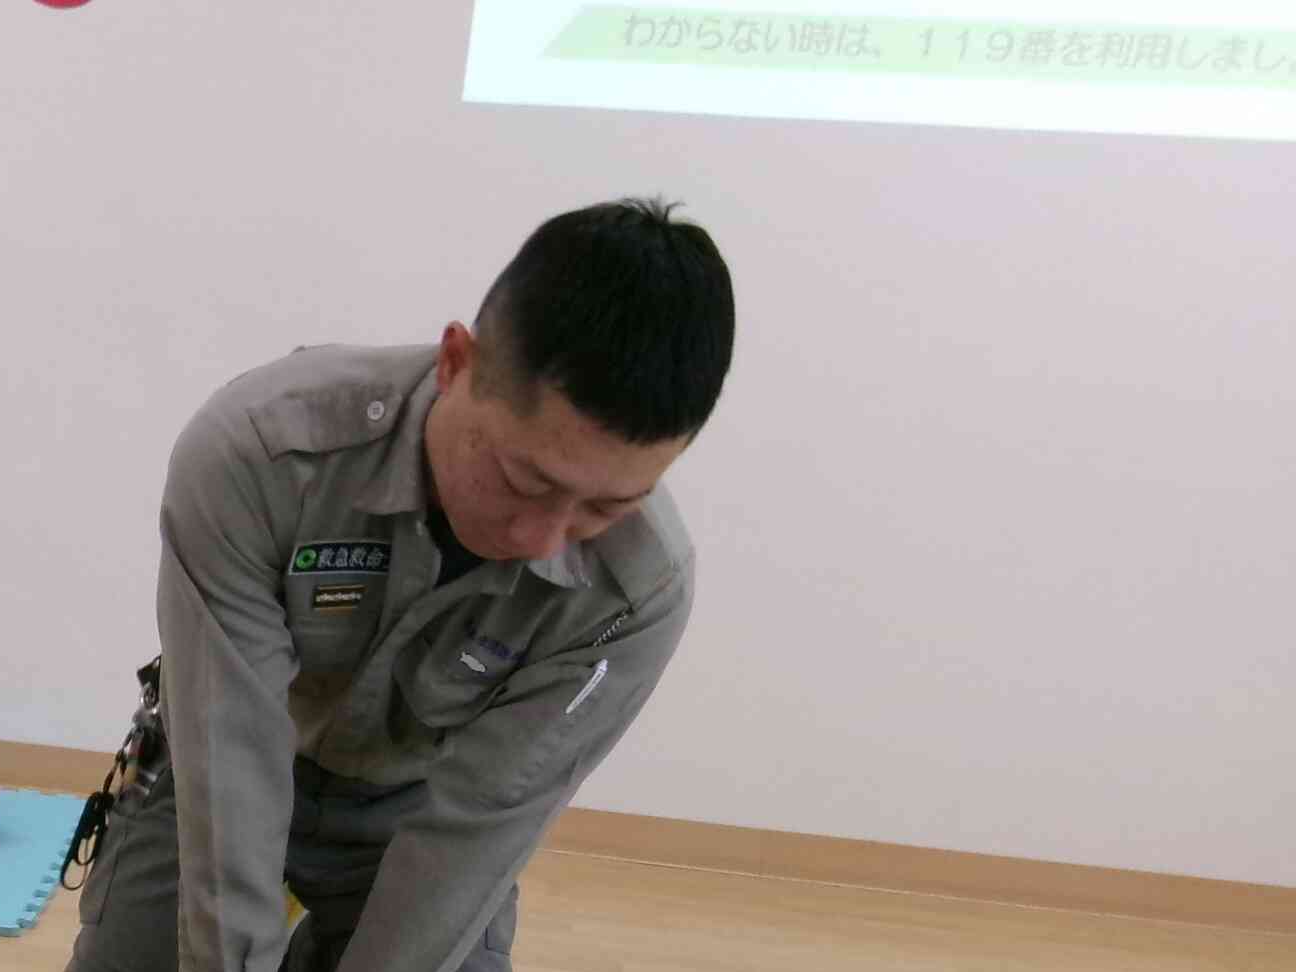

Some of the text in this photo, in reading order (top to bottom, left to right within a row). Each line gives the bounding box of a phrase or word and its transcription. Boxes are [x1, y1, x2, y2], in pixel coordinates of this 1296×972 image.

[622, 12, 1296, 75] わからない時は、119番を利用しまし
